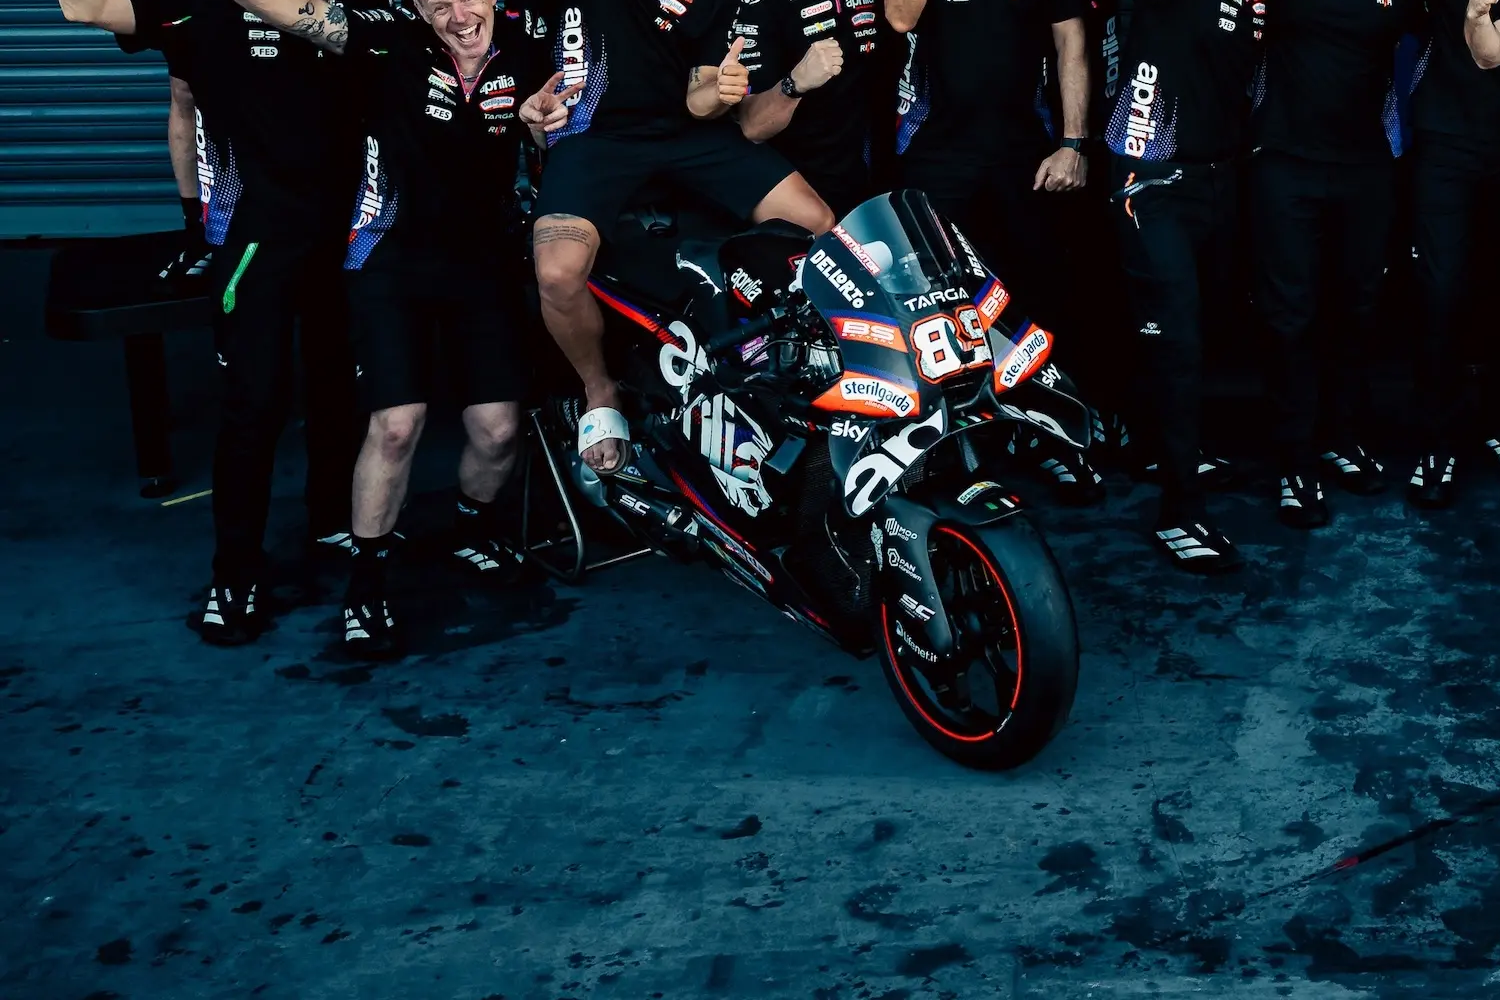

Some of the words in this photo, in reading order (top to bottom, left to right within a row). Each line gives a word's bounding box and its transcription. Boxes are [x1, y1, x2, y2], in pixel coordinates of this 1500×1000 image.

[806, 2, 831, 16] Castrol
[248, 29, 281, 40] BS
[804, 26, 817, 34] Green
[853, 27, 877, 38] TARGA
[1223, 20, 1235, 30] FES
[258, 47, 276, 57] FES
[433, 107, 451, 120] FES
[483, 112, 515, 120] TARGA
[1124, 60, 1159, 158] aprilia
[353, 135, 383, 230] aprilia
[831, 224, 882, 275] MARTINATOR
[730, 267, 763, 303] aprilia
[810, 248, 865, 309] DELLORTO
[904, 286, 970, 312] TARGA
[981, 285, 1006, 318] BS
[841, 320, 895, 341] BS
[911, 304, 994, 385] 89
[1003, 333, 1046, 384] sterilgarda
[1041, 363, 1062, 388] sky
[844, 381, 911, 412] sterilgarda
[830, 419, 870, 443] sky
[619, 493, 650, 516] SC
[899, 525, 918, 541] MOD
[900, 593, 936, 622] SC
[902, 626, 938, 663] Lifenet.it
